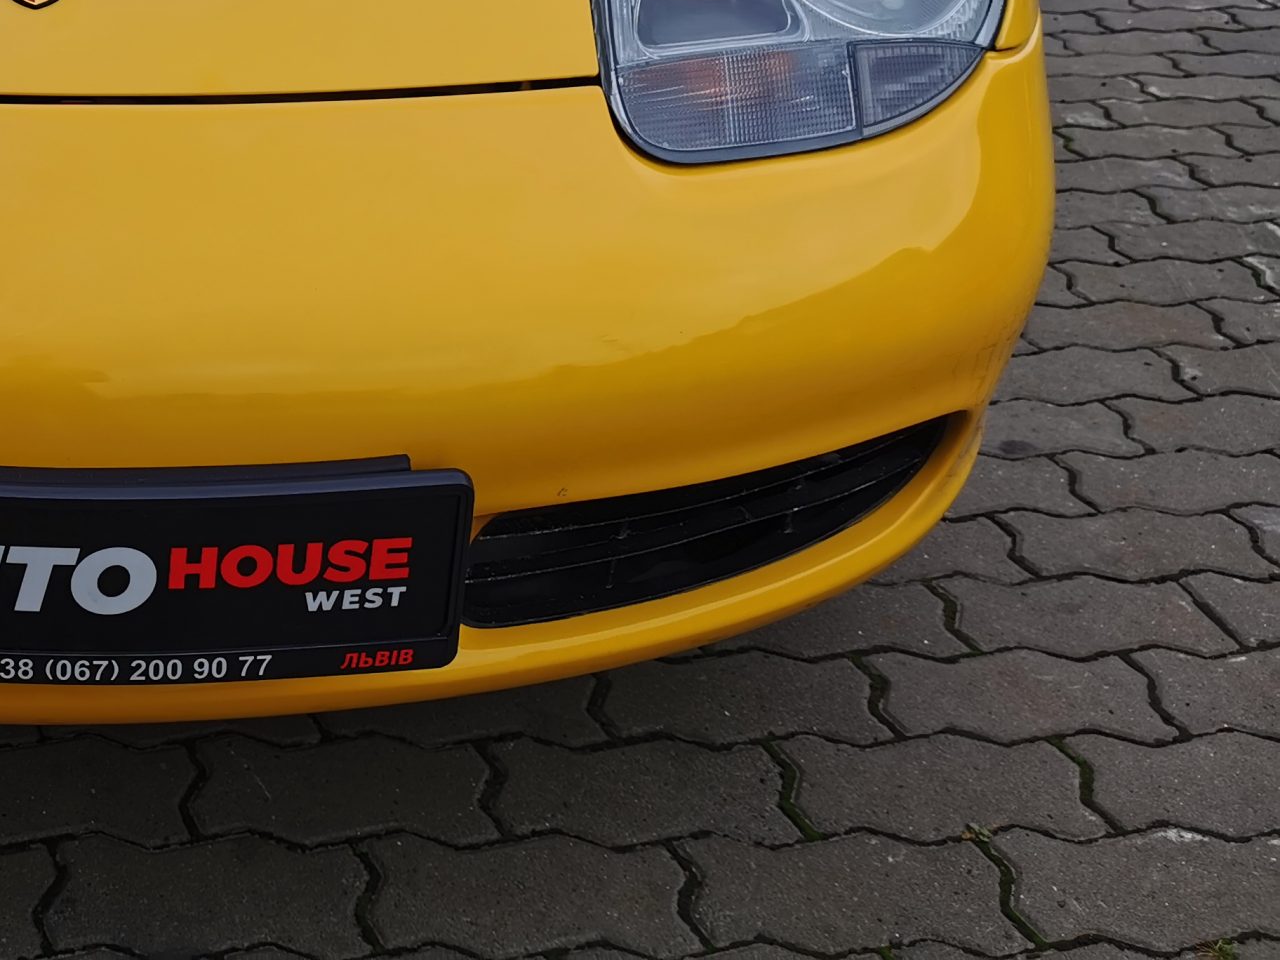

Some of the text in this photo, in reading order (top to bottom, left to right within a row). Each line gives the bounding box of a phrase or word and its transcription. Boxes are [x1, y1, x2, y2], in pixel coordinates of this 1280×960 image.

[168, 537, 413, 589] HOUSE
[305, 586, 407, 612] WEST
[0, 658, 34, 680] 38
[45, 658, 119, 681] (067)
[130, 658, 183, 681] 200
[193, 657, 228, 679] 90
[239, 655, 273, 676] 77
[340, 649, 414, 669] ЛЬВІВ
